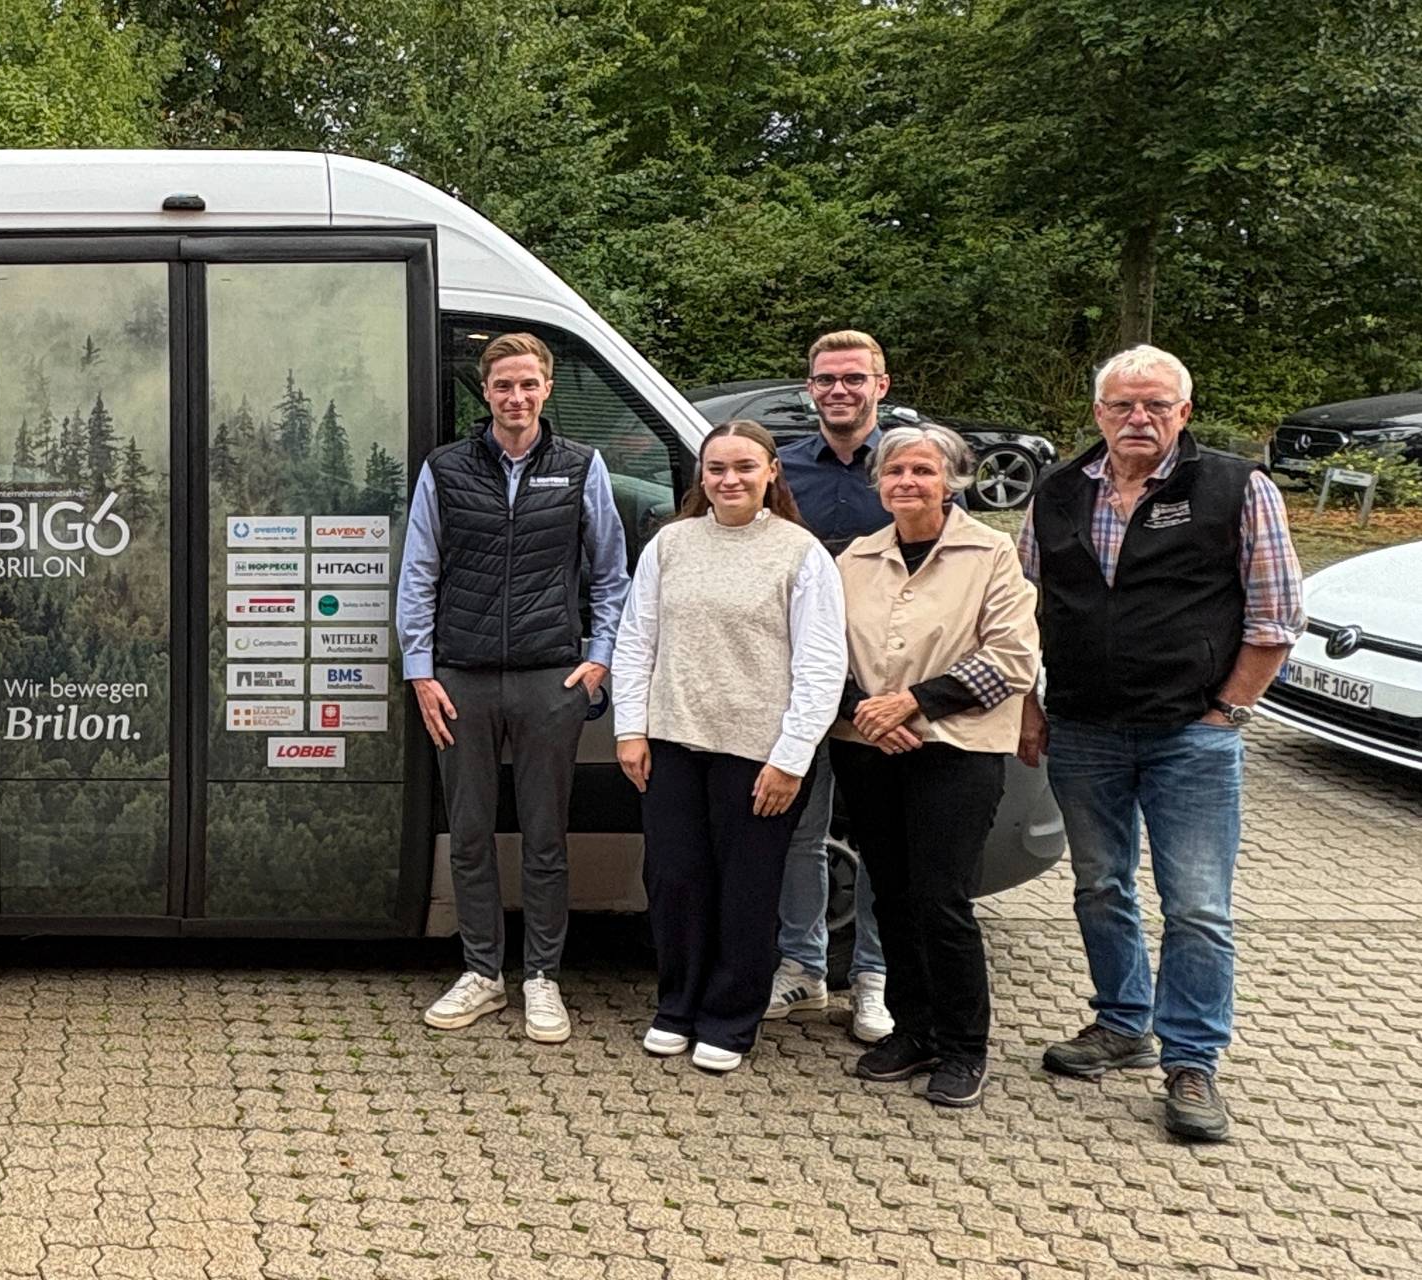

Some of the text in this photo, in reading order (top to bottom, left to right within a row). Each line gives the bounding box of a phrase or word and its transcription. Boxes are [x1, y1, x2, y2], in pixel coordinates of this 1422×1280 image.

[316, 527, 366, 536] CLAYENS
[248, 562, 299, 571] HOPPECKE
[316, 562, 384, 575] HITACHI
[249, 605, 296, 614] EGGER
[321, 633, 379, 645] WITTELER
[327, 668, 363, 682] BMS
[4, 677, 148, 703] Wir bewegen
[1287, 663, 1370, 705] MA HE 1062
[3, 704, 141, 741] Brilon.
[276, 745, 338, 758] LOBBE
